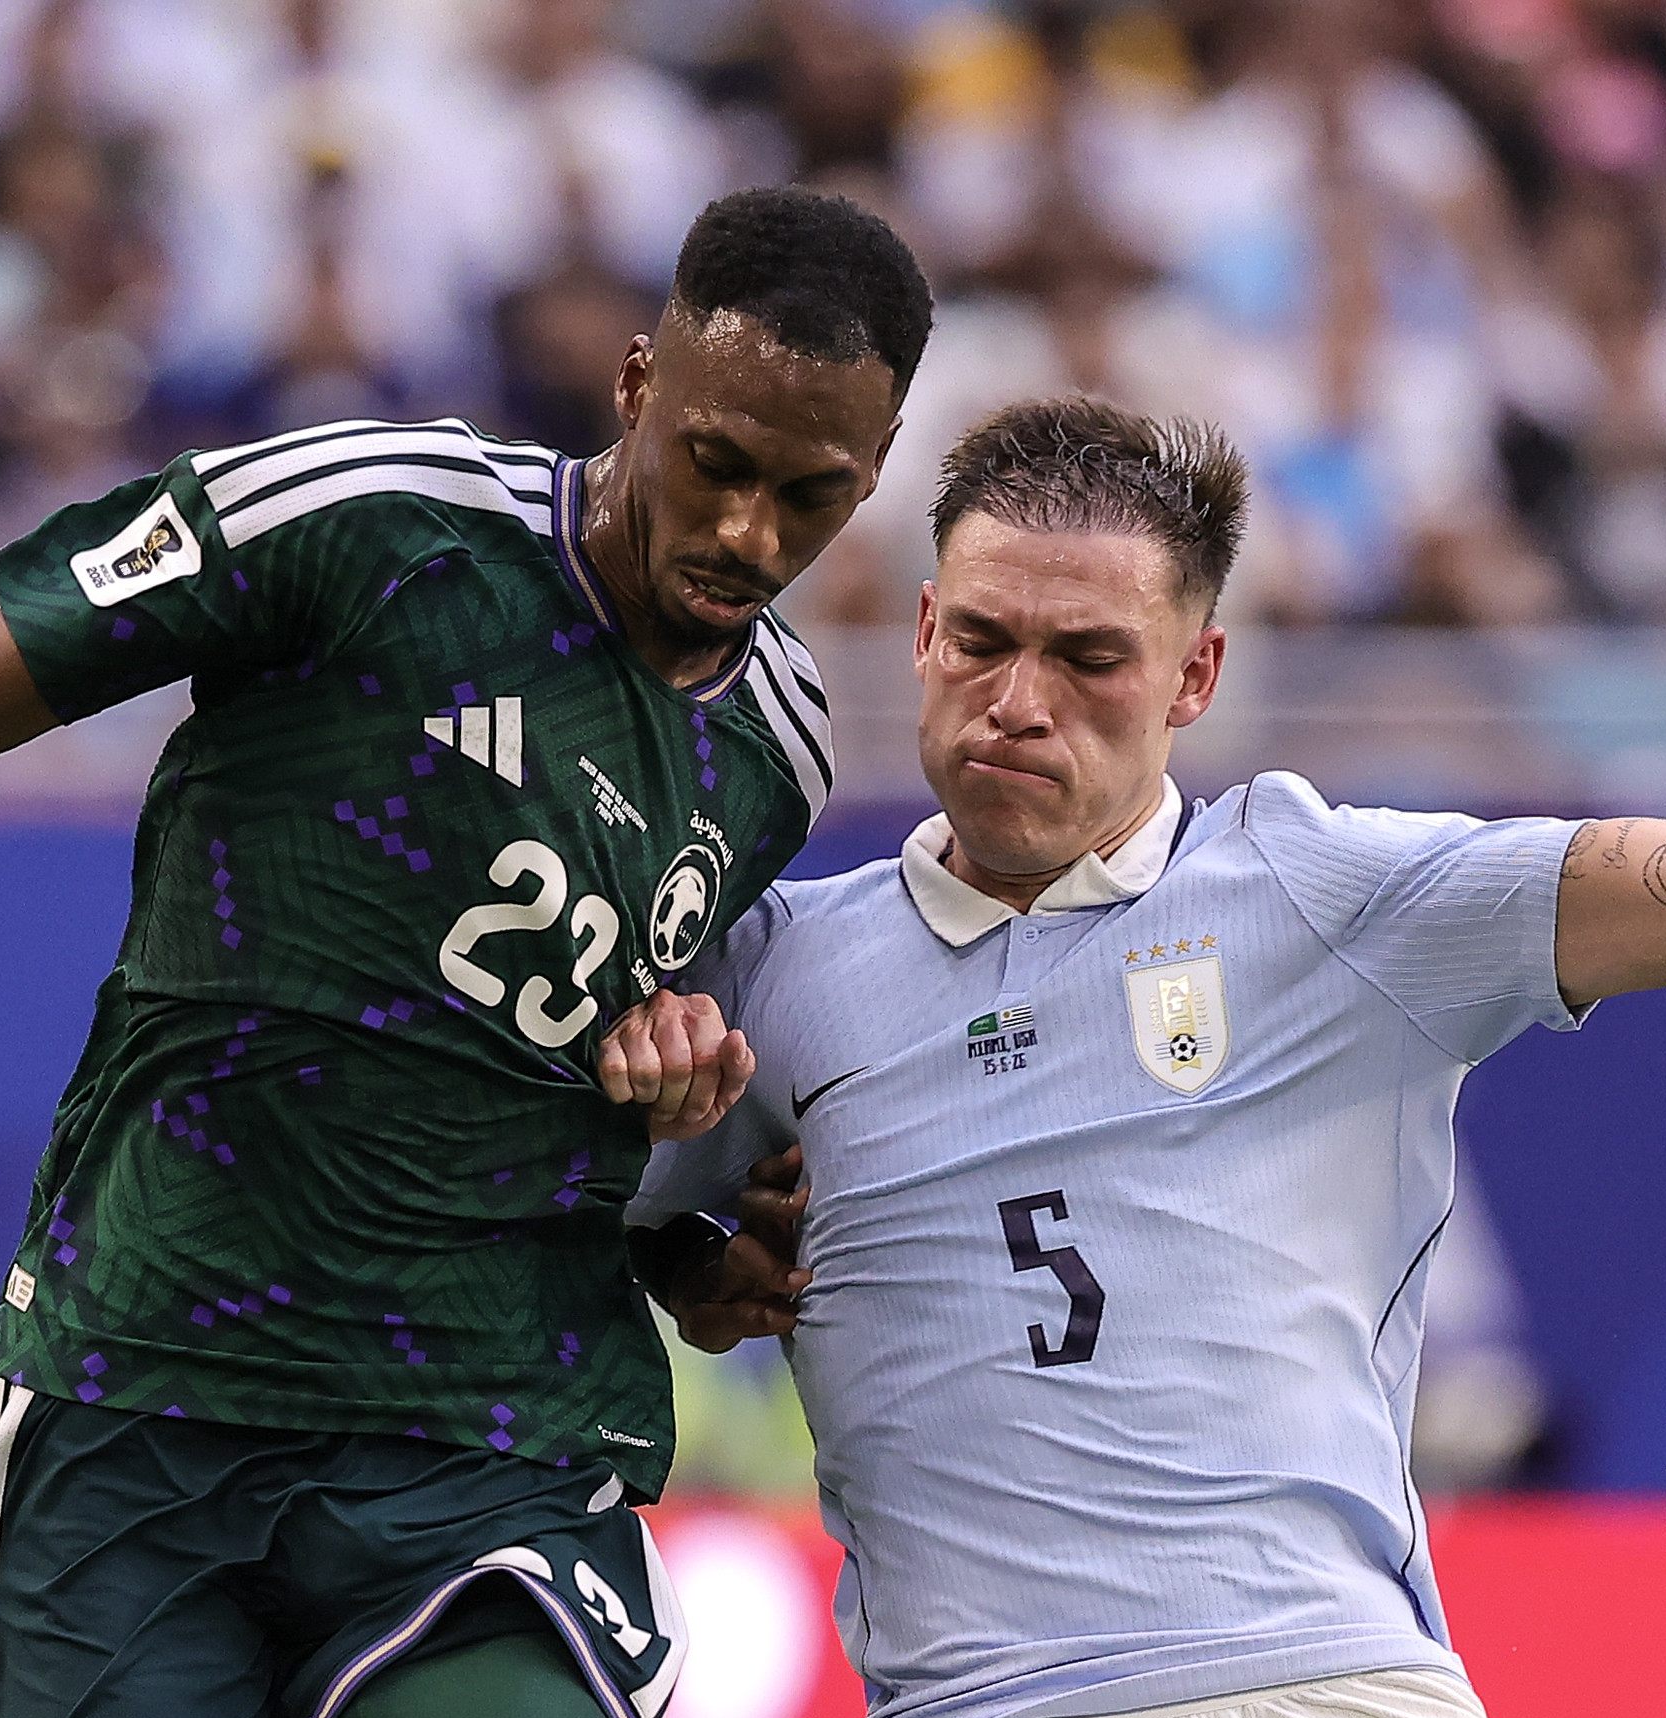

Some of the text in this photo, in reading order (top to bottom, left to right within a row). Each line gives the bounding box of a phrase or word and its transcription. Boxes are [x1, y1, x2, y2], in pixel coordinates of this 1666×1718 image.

[86, 566, 106, 588] 2026
[689, 809, 733, 870] السعودية
[439, 839, 620, 1048] 23
[997, 1189, 1105, 1368] 5
